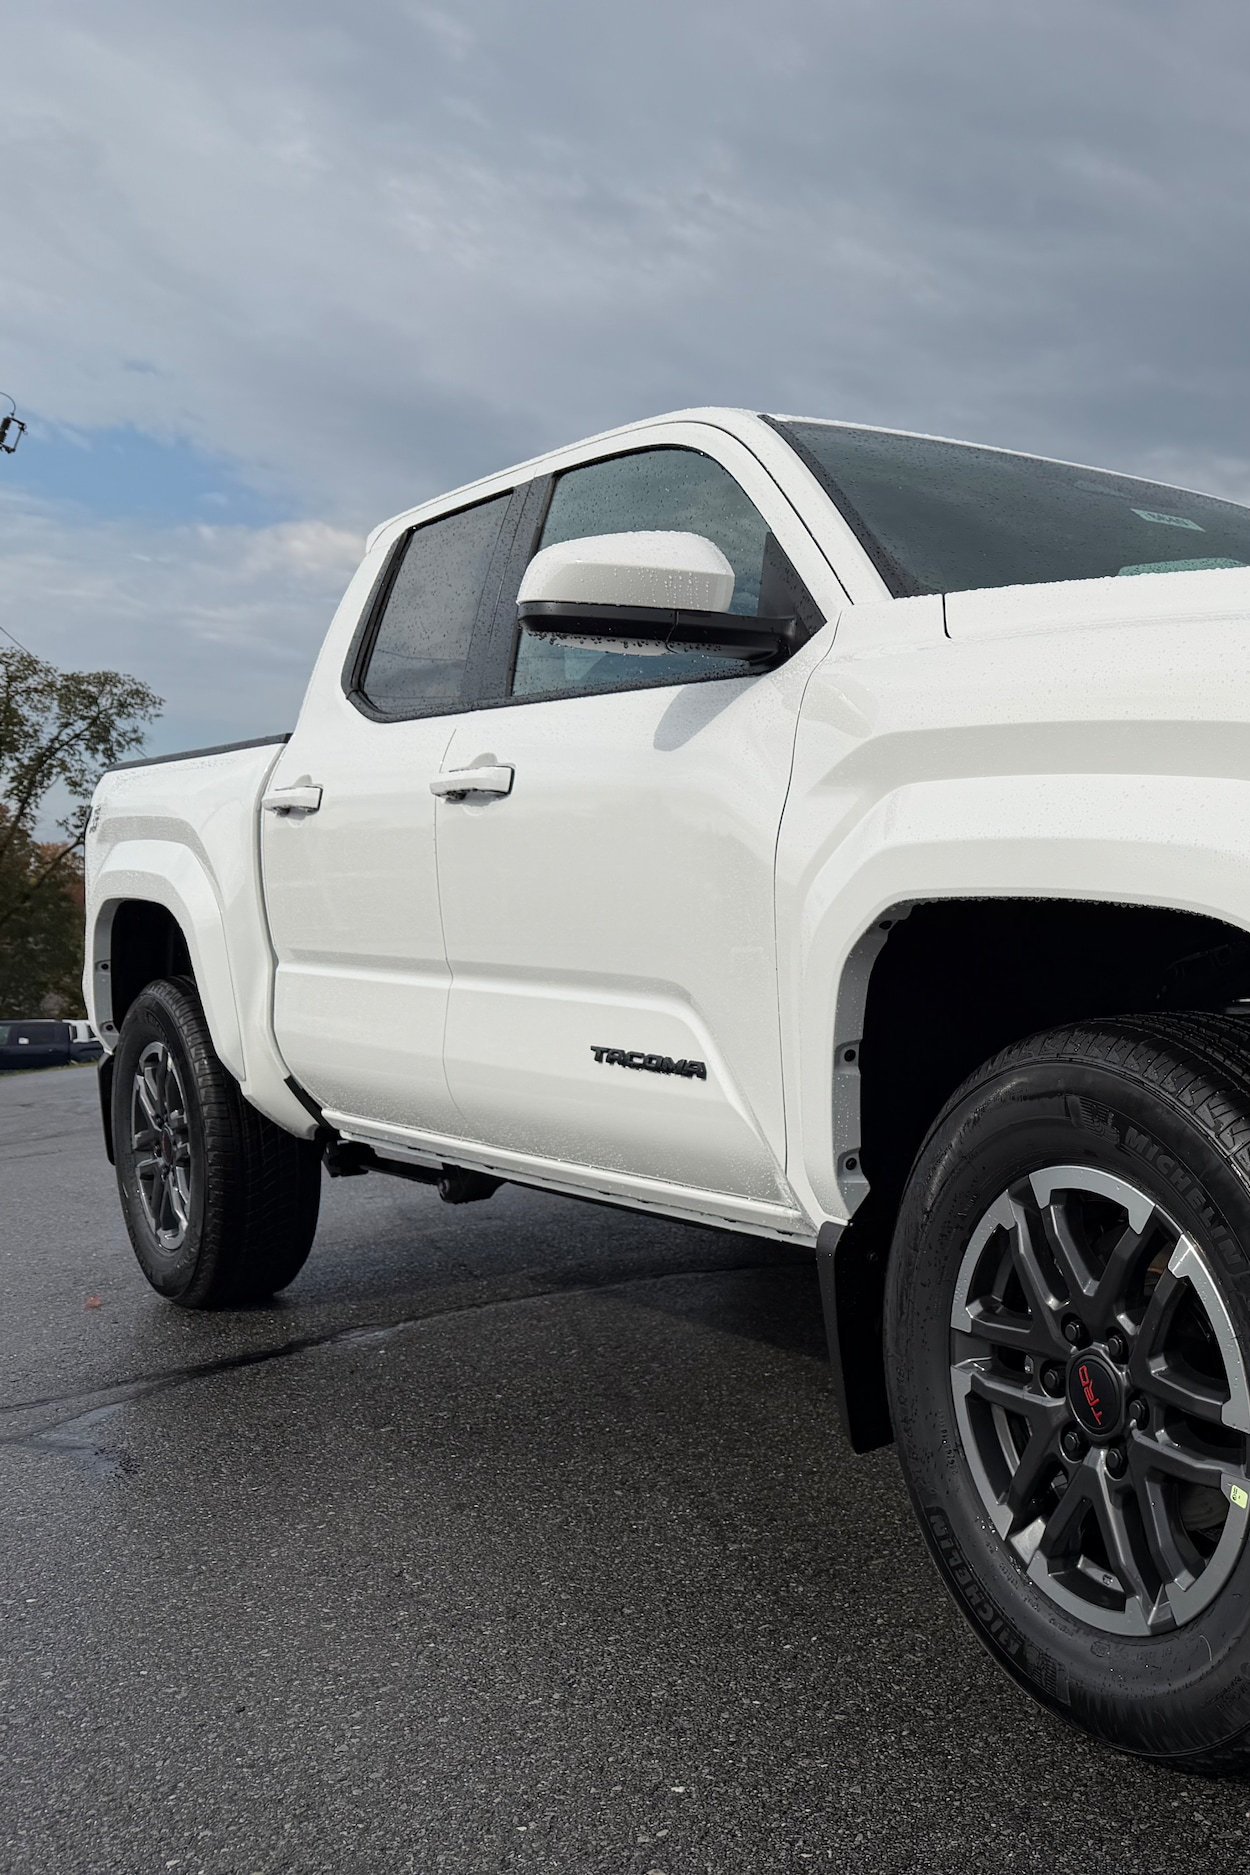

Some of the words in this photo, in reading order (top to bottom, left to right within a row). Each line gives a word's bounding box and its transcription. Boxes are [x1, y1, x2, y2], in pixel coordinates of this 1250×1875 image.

[590, 1045, 707, 1081] TACOMA
[1124, 1125, 1243, 1265] MICHELIN
[1078, 1364, 1104, 1425] TRD
[929, 1514, 1021, 1656] MICHELIN
